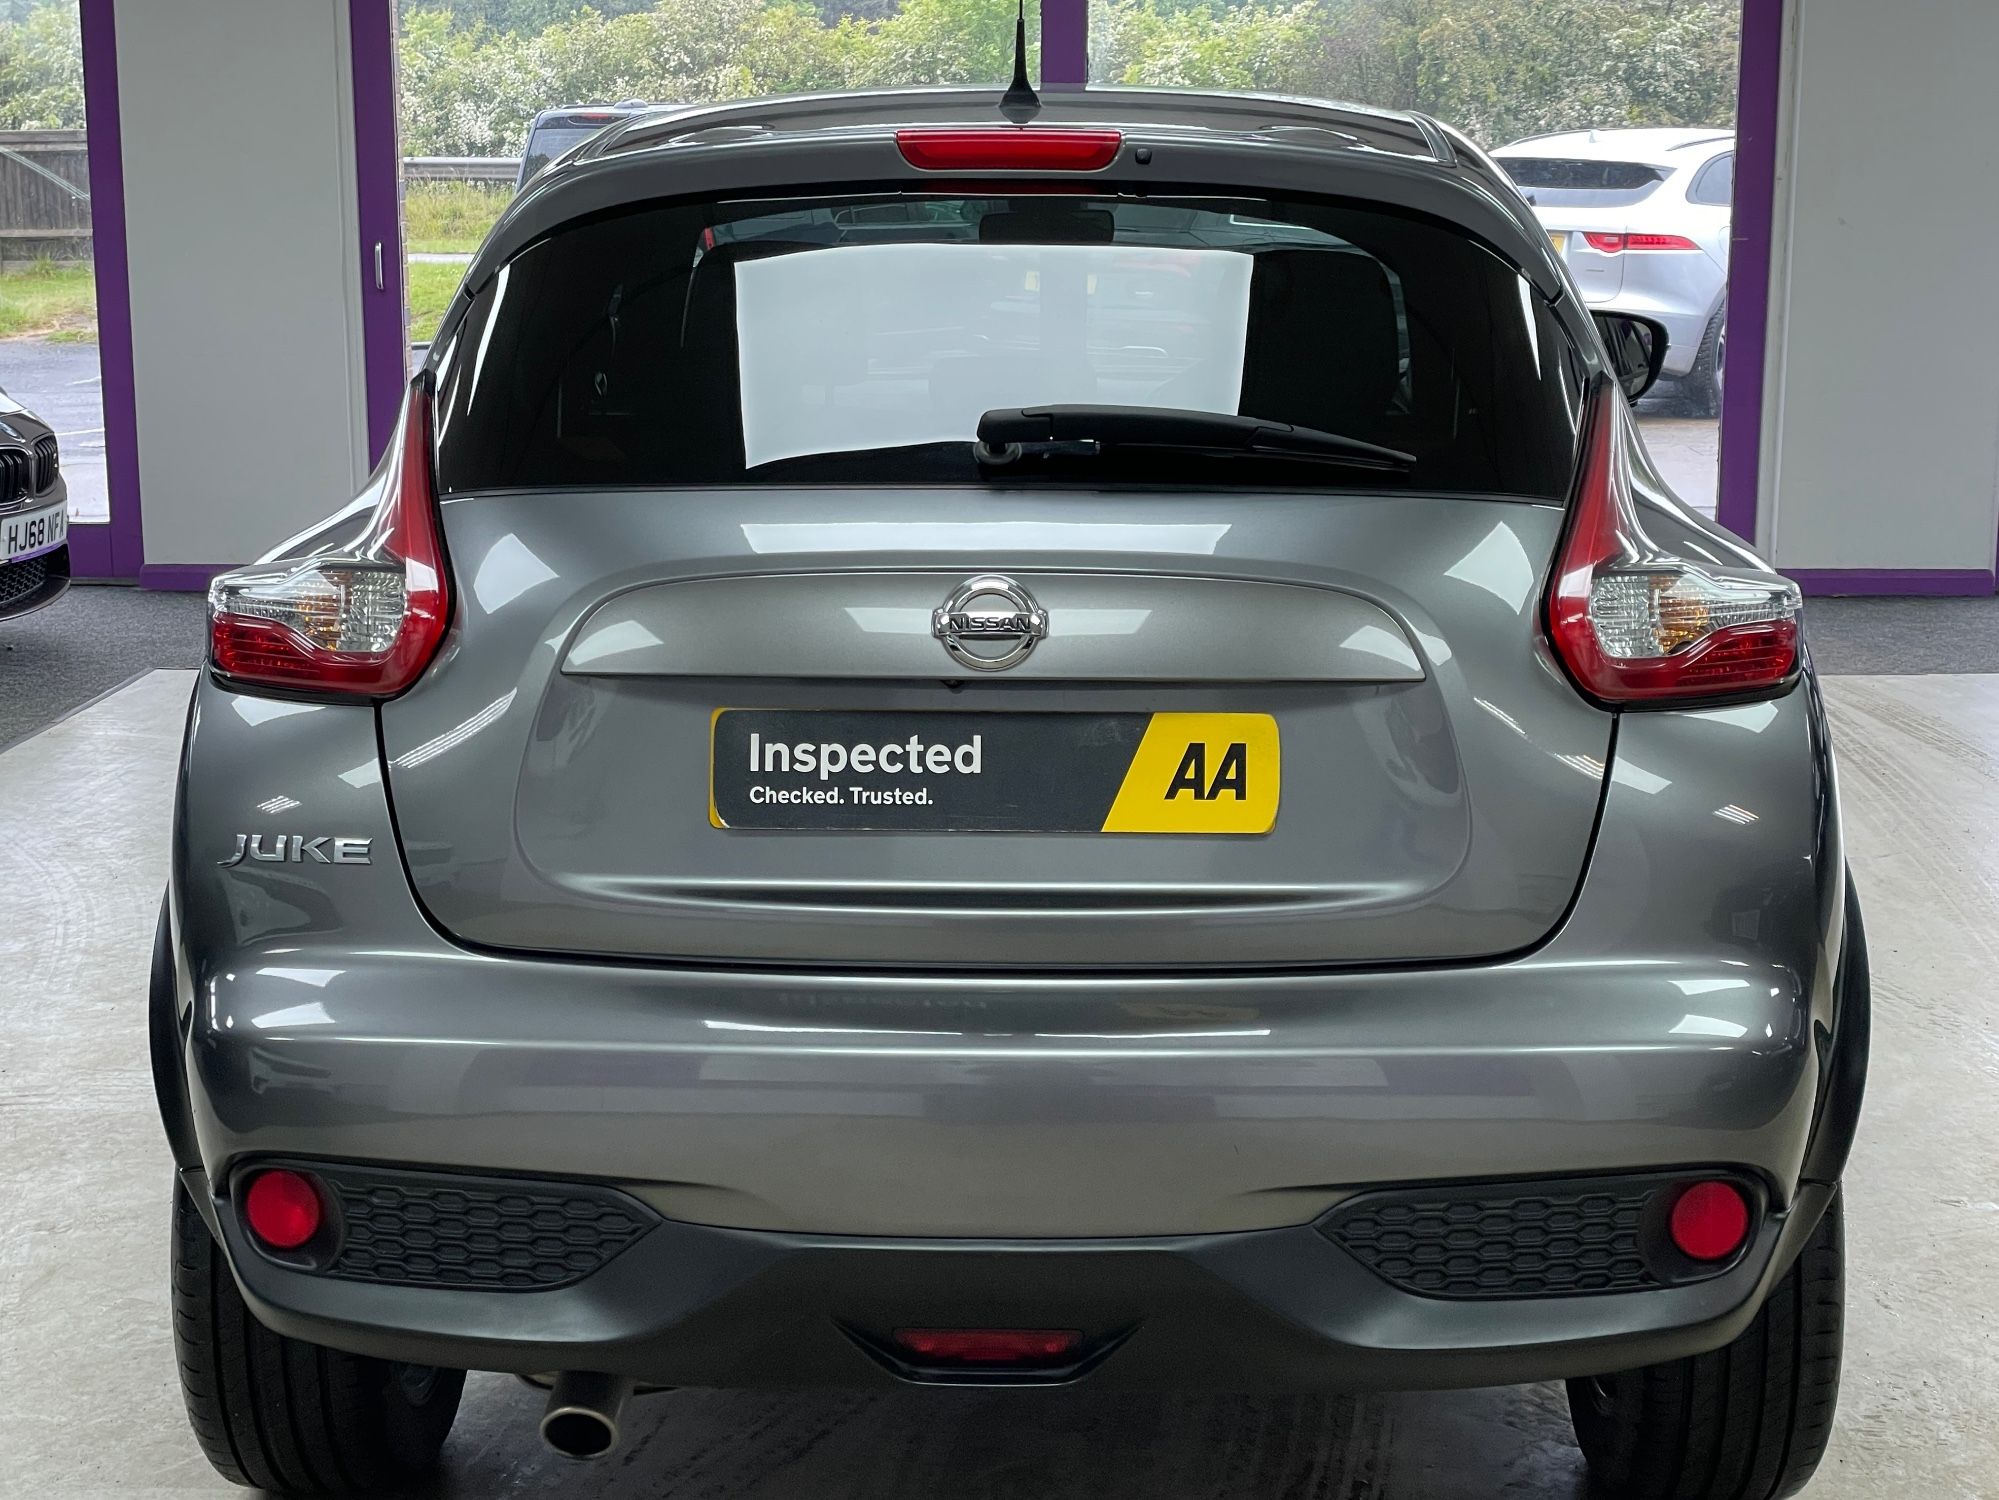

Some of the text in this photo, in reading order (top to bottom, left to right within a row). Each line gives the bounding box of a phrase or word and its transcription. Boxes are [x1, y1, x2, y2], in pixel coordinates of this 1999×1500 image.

[8, 518, 46, 554] HJ68
[949, 616, 1031, 631] NISSAN
[750, 733, 982, 780] Inspected
[1163, 742, 1247, 800] AA
[749, 786, 934, 805] Checked. Trusted.
[216, 834, 373, 868] JUKE
